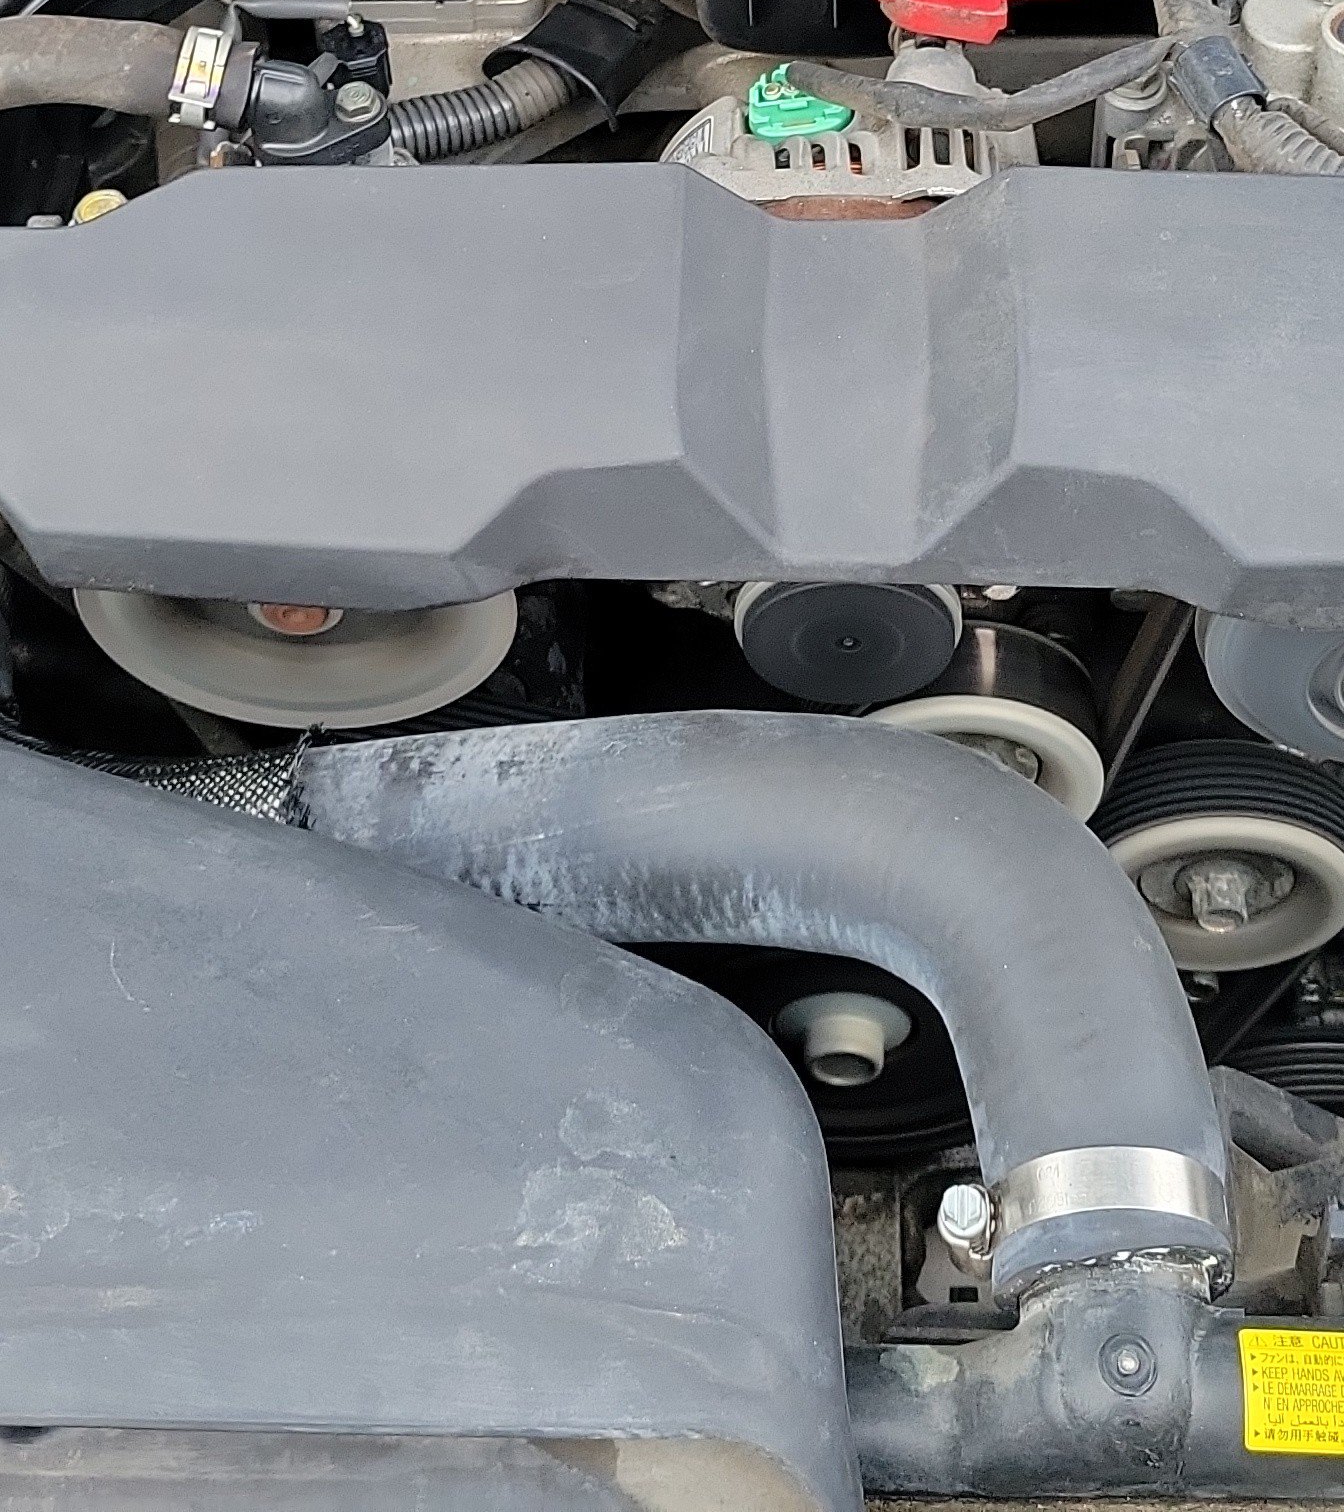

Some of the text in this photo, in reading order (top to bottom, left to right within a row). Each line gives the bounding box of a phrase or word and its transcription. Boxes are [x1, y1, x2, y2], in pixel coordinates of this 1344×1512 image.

[1273, 1334, 1305, 1348] 注意
[1292, 1368, 1330, 1383] HANDS
[1262, 1381, 1274, 1396] LE
[1276, 1397, 1289, 1412] EN
